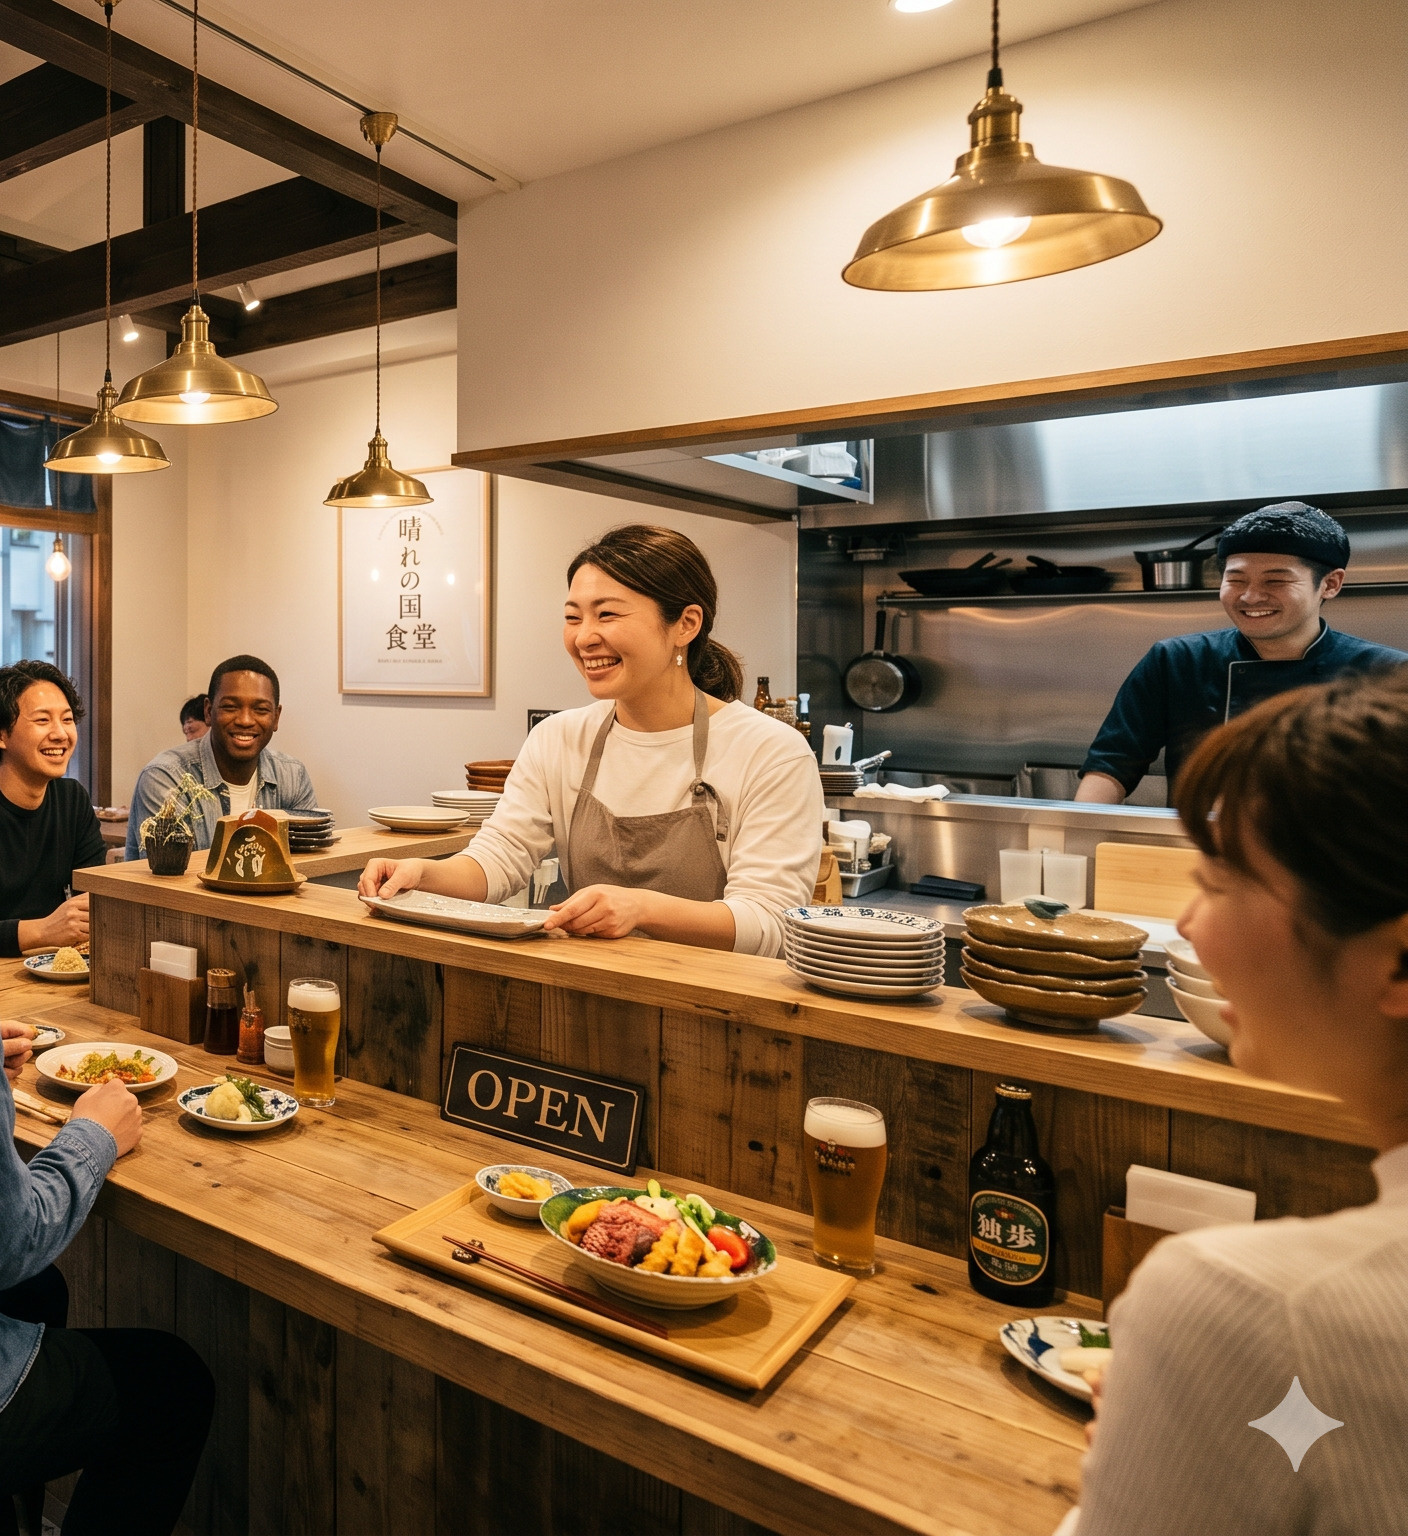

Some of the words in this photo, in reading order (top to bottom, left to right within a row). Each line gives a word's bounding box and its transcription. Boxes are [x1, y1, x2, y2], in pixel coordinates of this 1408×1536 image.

[399, 516, 422, 619] 晴れの国
[385, 623, 437, 651] 食堂
[467, 1069, 615, 1143] OPEN
[977, 1212, 1036, 1249] 独歩
